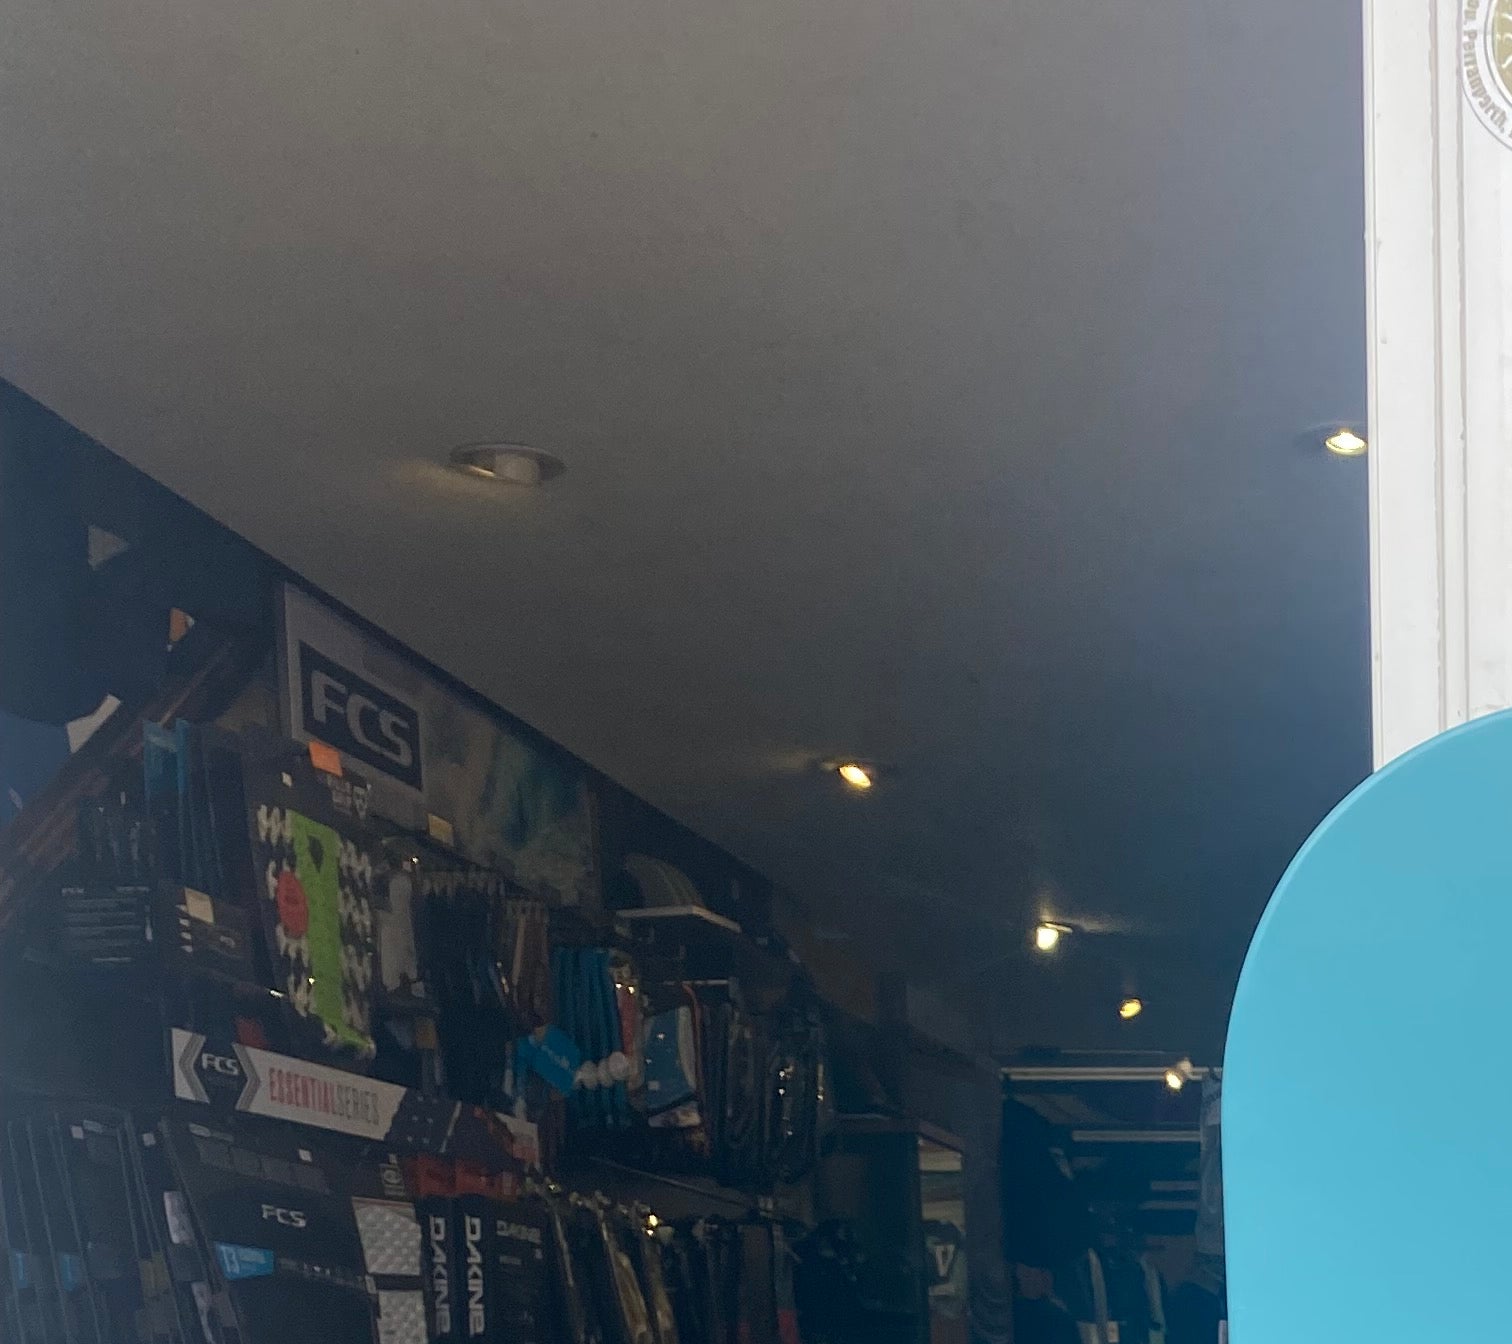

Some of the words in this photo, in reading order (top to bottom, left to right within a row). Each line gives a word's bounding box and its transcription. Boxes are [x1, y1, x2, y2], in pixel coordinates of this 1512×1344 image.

[311, 669, 412, 768] FCS
[202, 1053, 239, 1076] FCS
[261, 1203, 307, 1229] FCS
[429, 1213, 451, 1337] DAKINE
[464, 1212, 486, 1338] DAKINE
